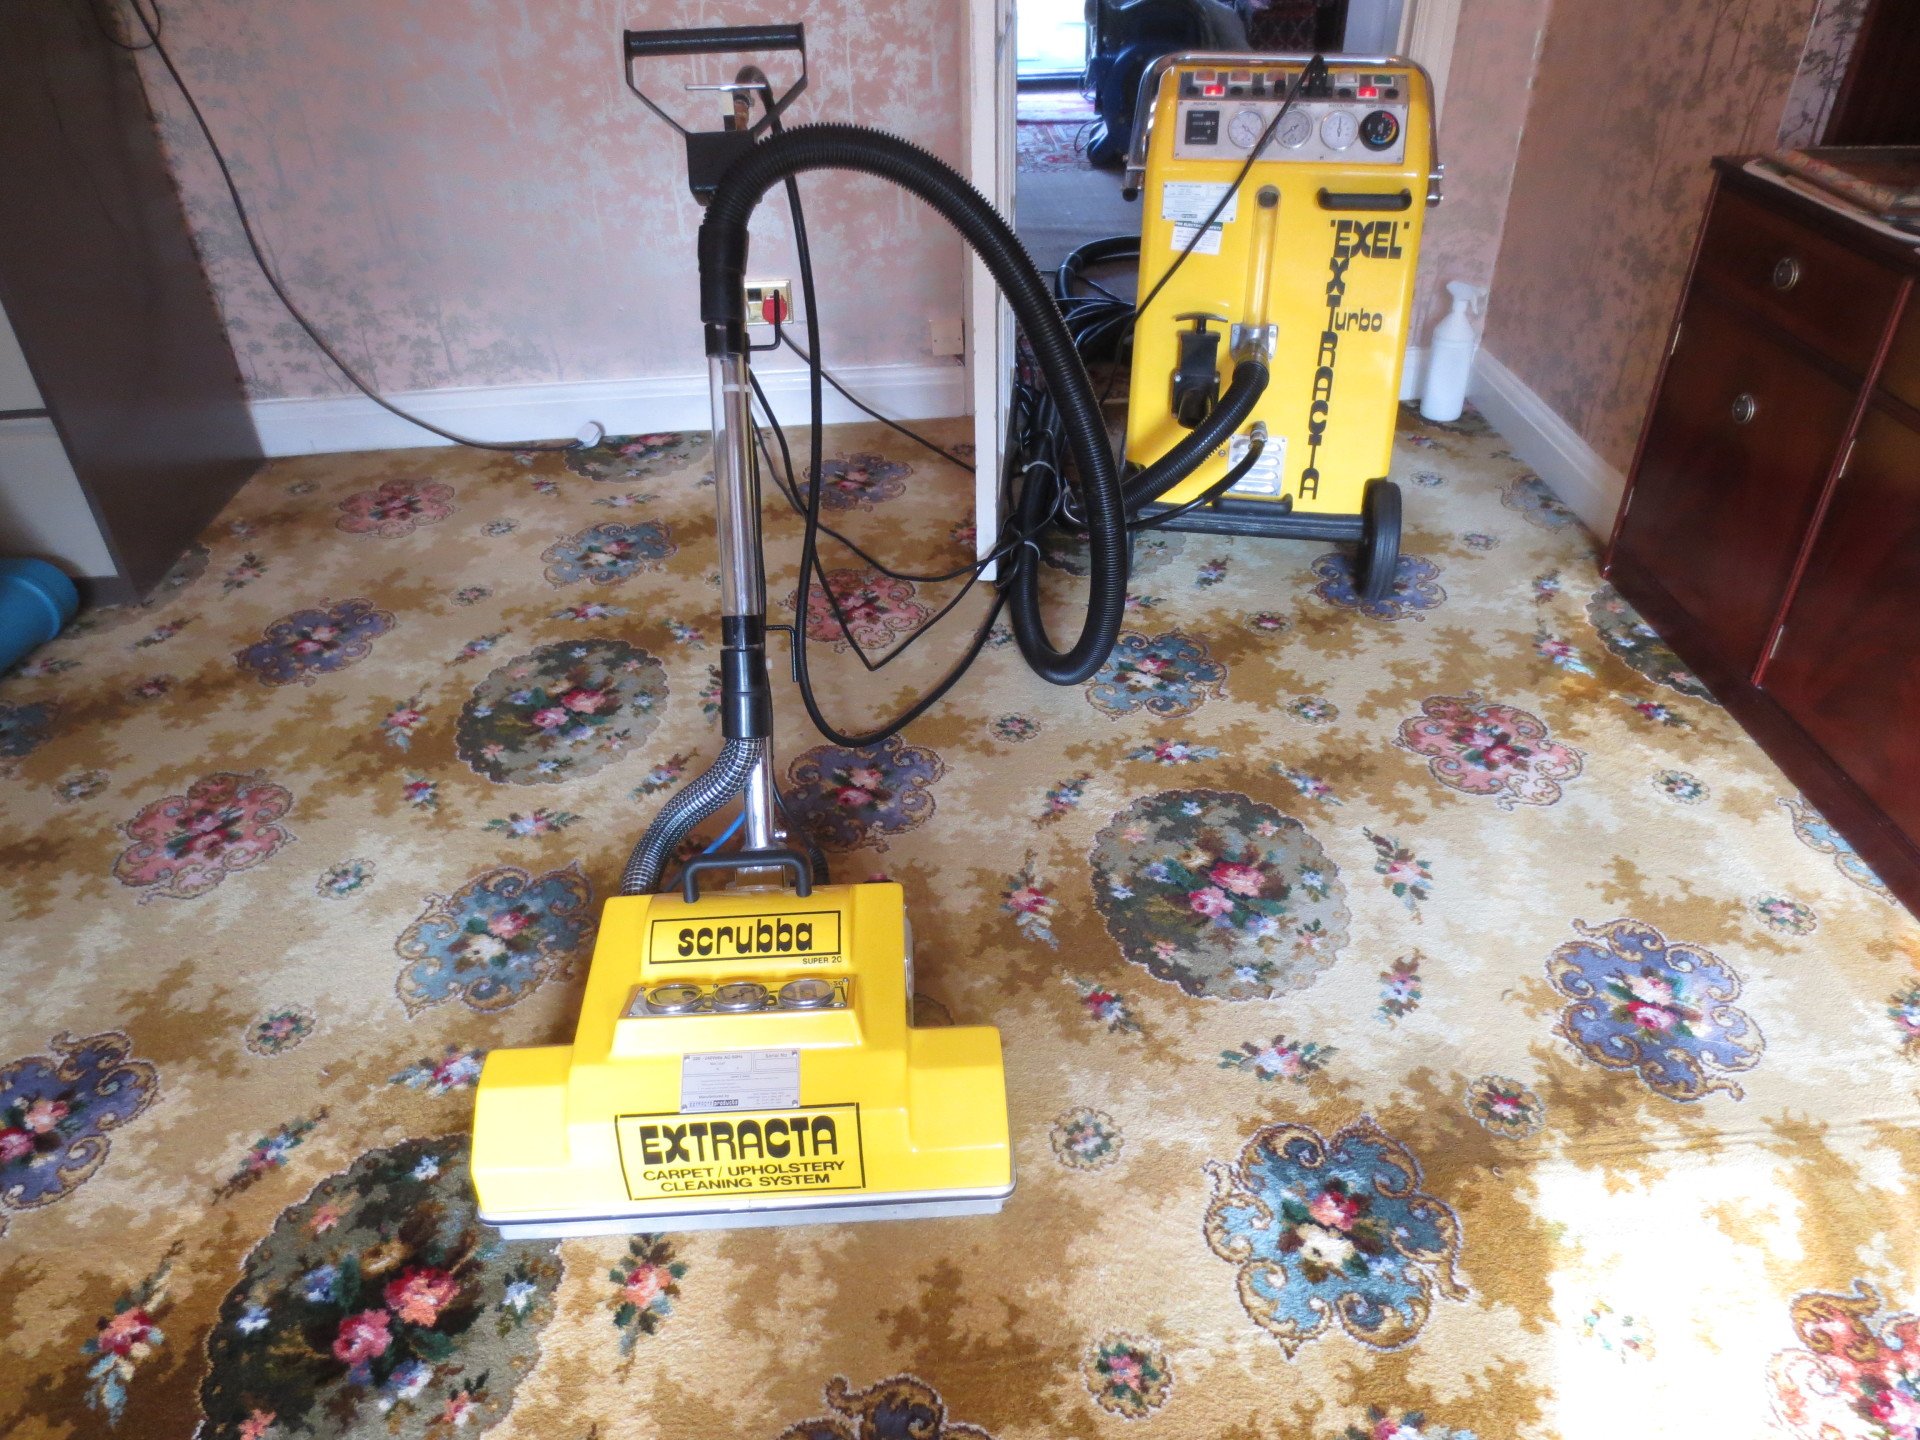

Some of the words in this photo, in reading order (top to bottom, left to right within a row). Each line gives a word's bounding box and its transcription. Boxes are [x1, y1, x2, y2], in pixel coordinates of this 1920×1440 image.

[677, 917, 813, 957] scrubba
[802, 957, 829, 965] SUPER
[639, 1115, 838, 1165] EXTRACTA
[643, 1167, 713, 1181] CARPET
[727, 1161, 845, 1177] UPHOLSTERY
[660, 1177, 752, 1192] CLEANING
[759, 1174, 831, 1187] SYSTEM
